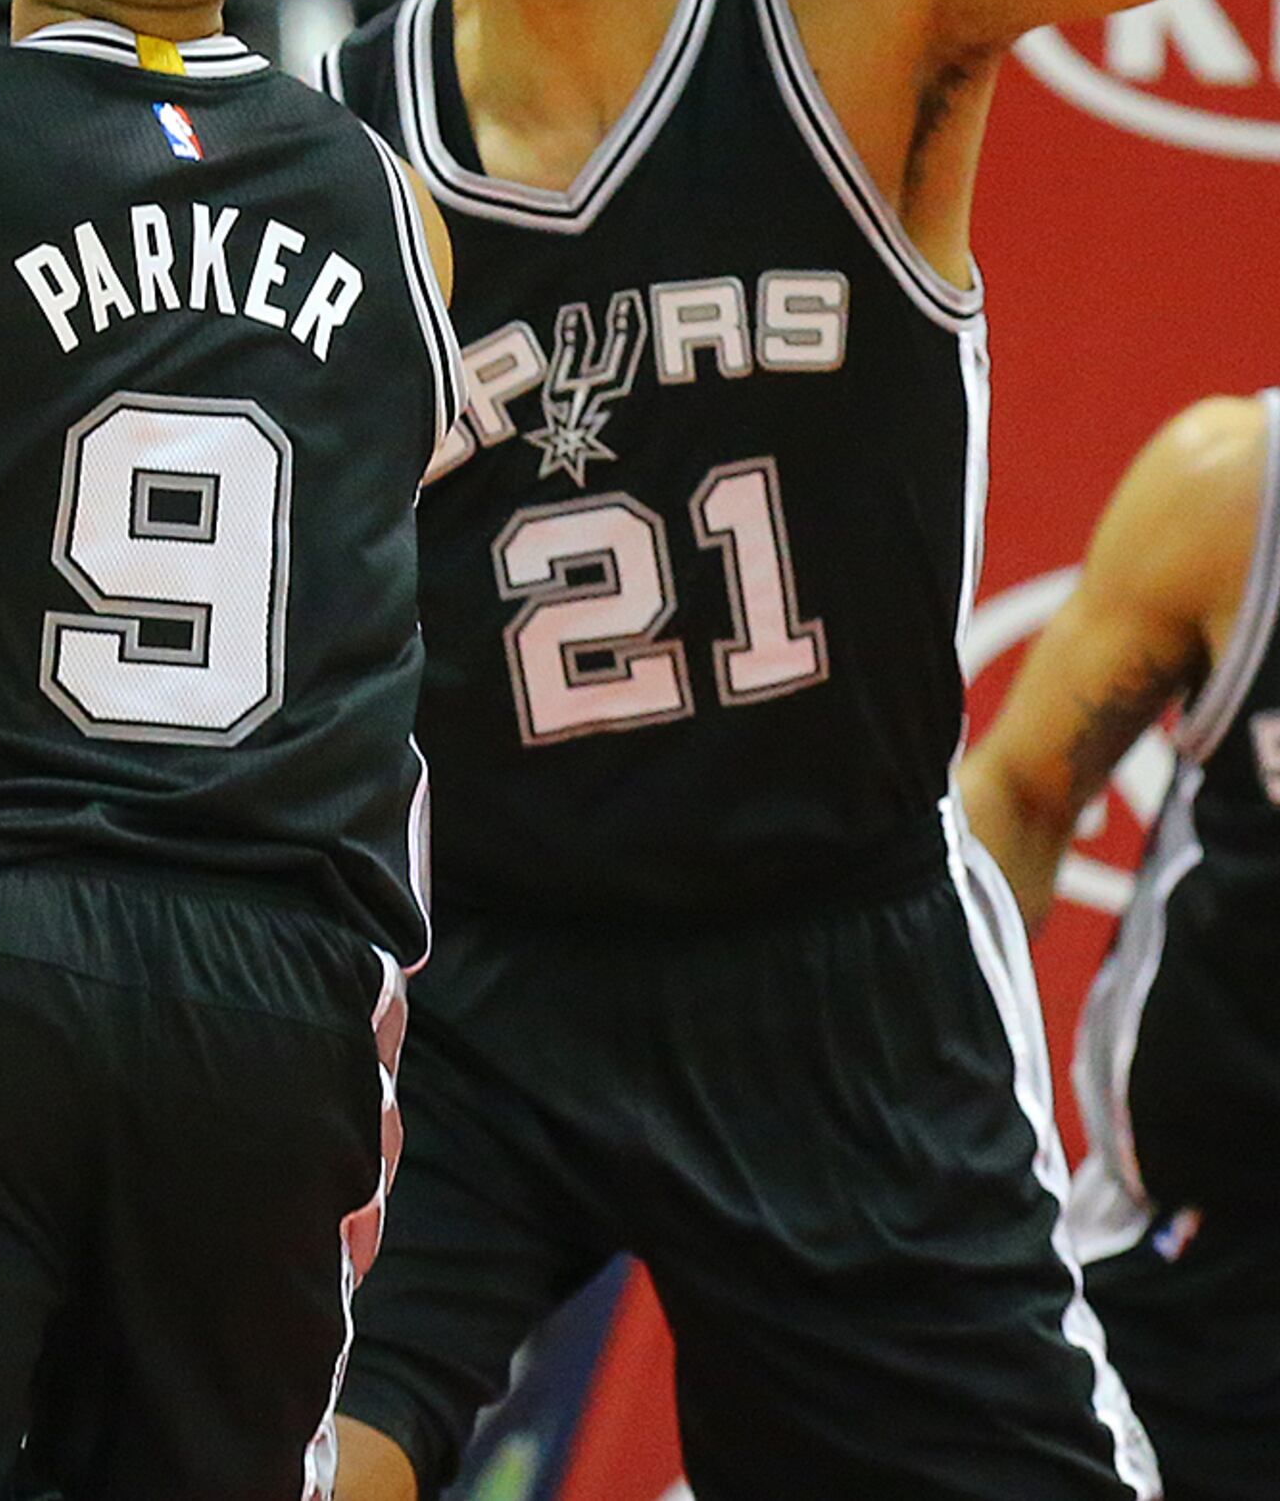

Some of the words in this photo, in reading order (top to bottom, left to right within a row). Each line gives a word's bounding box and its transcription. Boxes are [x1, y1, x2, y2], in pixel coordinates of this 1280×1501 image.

[14, 202, 365, 364] PARKER
[39, 390, 293, 748] 9
[490, 456, 830, 748] 21
